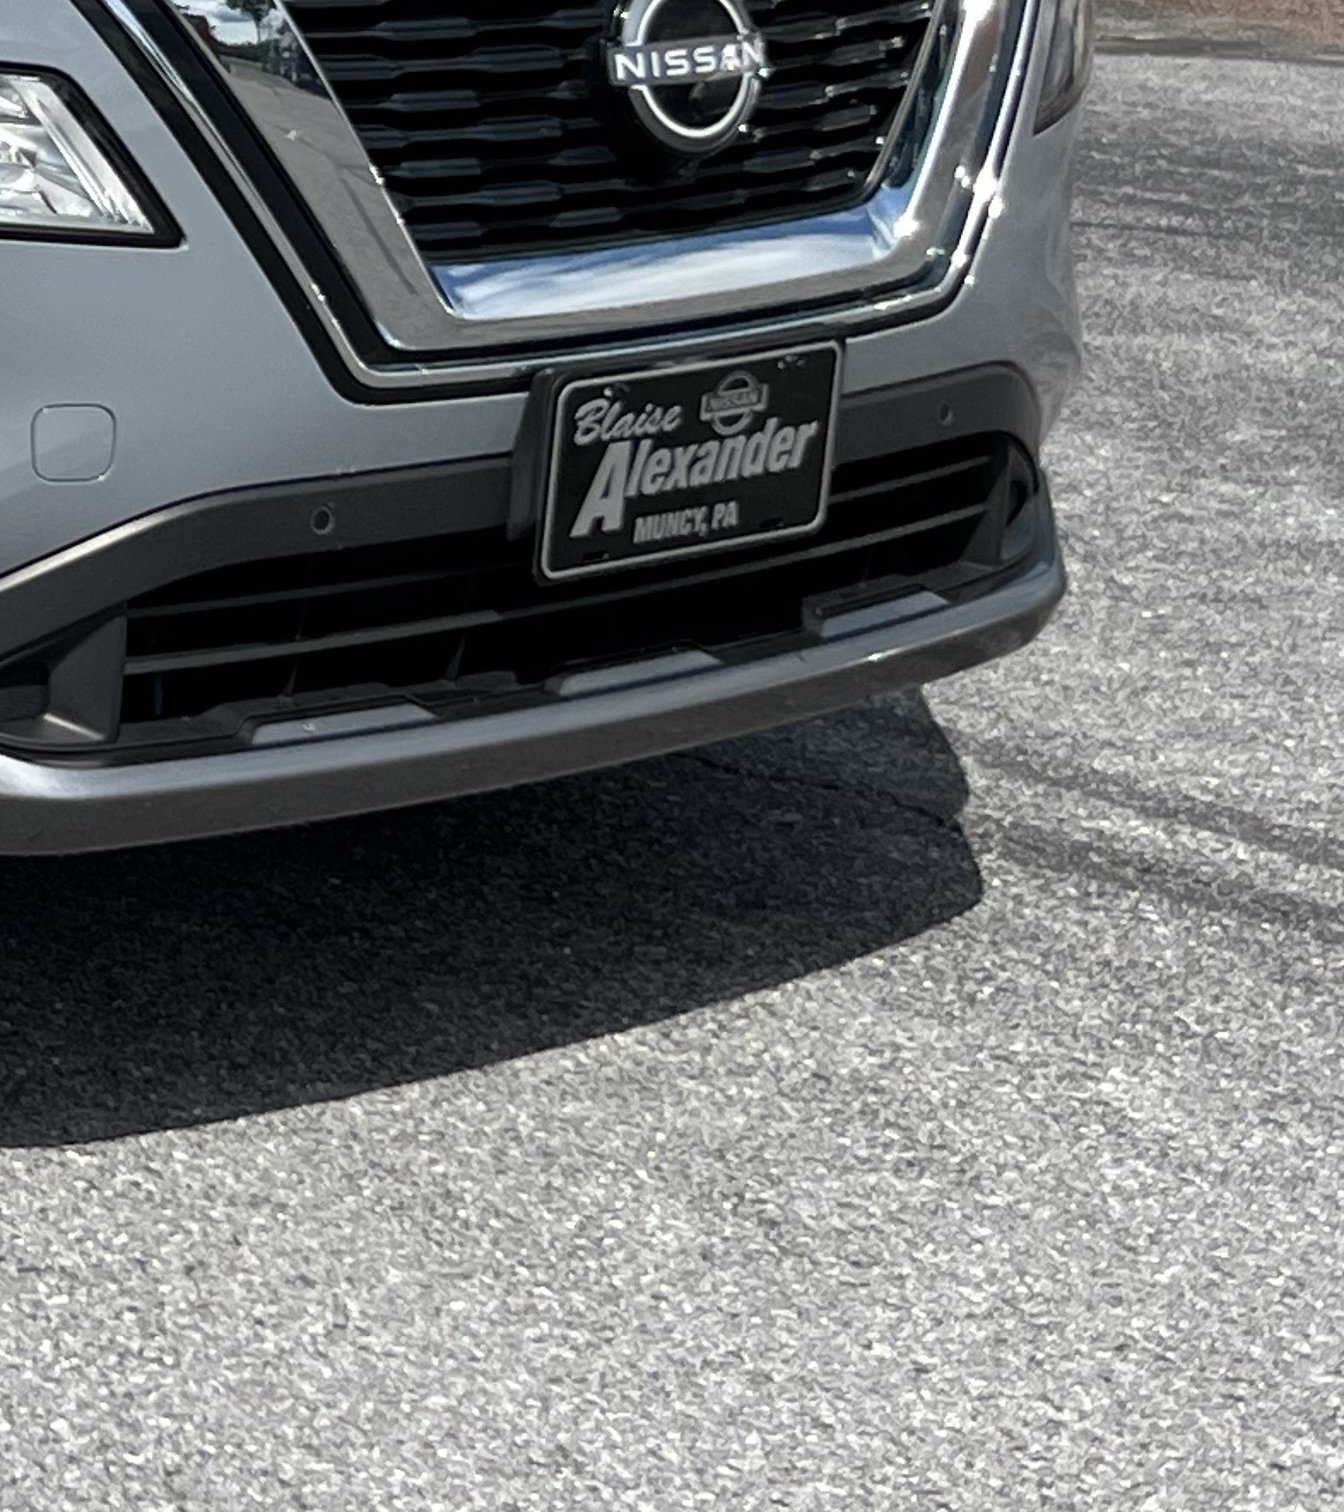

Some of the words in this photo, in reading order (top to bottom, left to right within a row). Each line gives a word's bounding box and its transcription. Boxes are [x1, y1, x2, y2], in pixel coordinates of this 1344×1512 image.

[614, 41, 765, 80] NISSAN
[574, 396, 683, 446] Blaise
[569, 416, 819, 539] Alexander
[711, 500, 739, 530] PA
